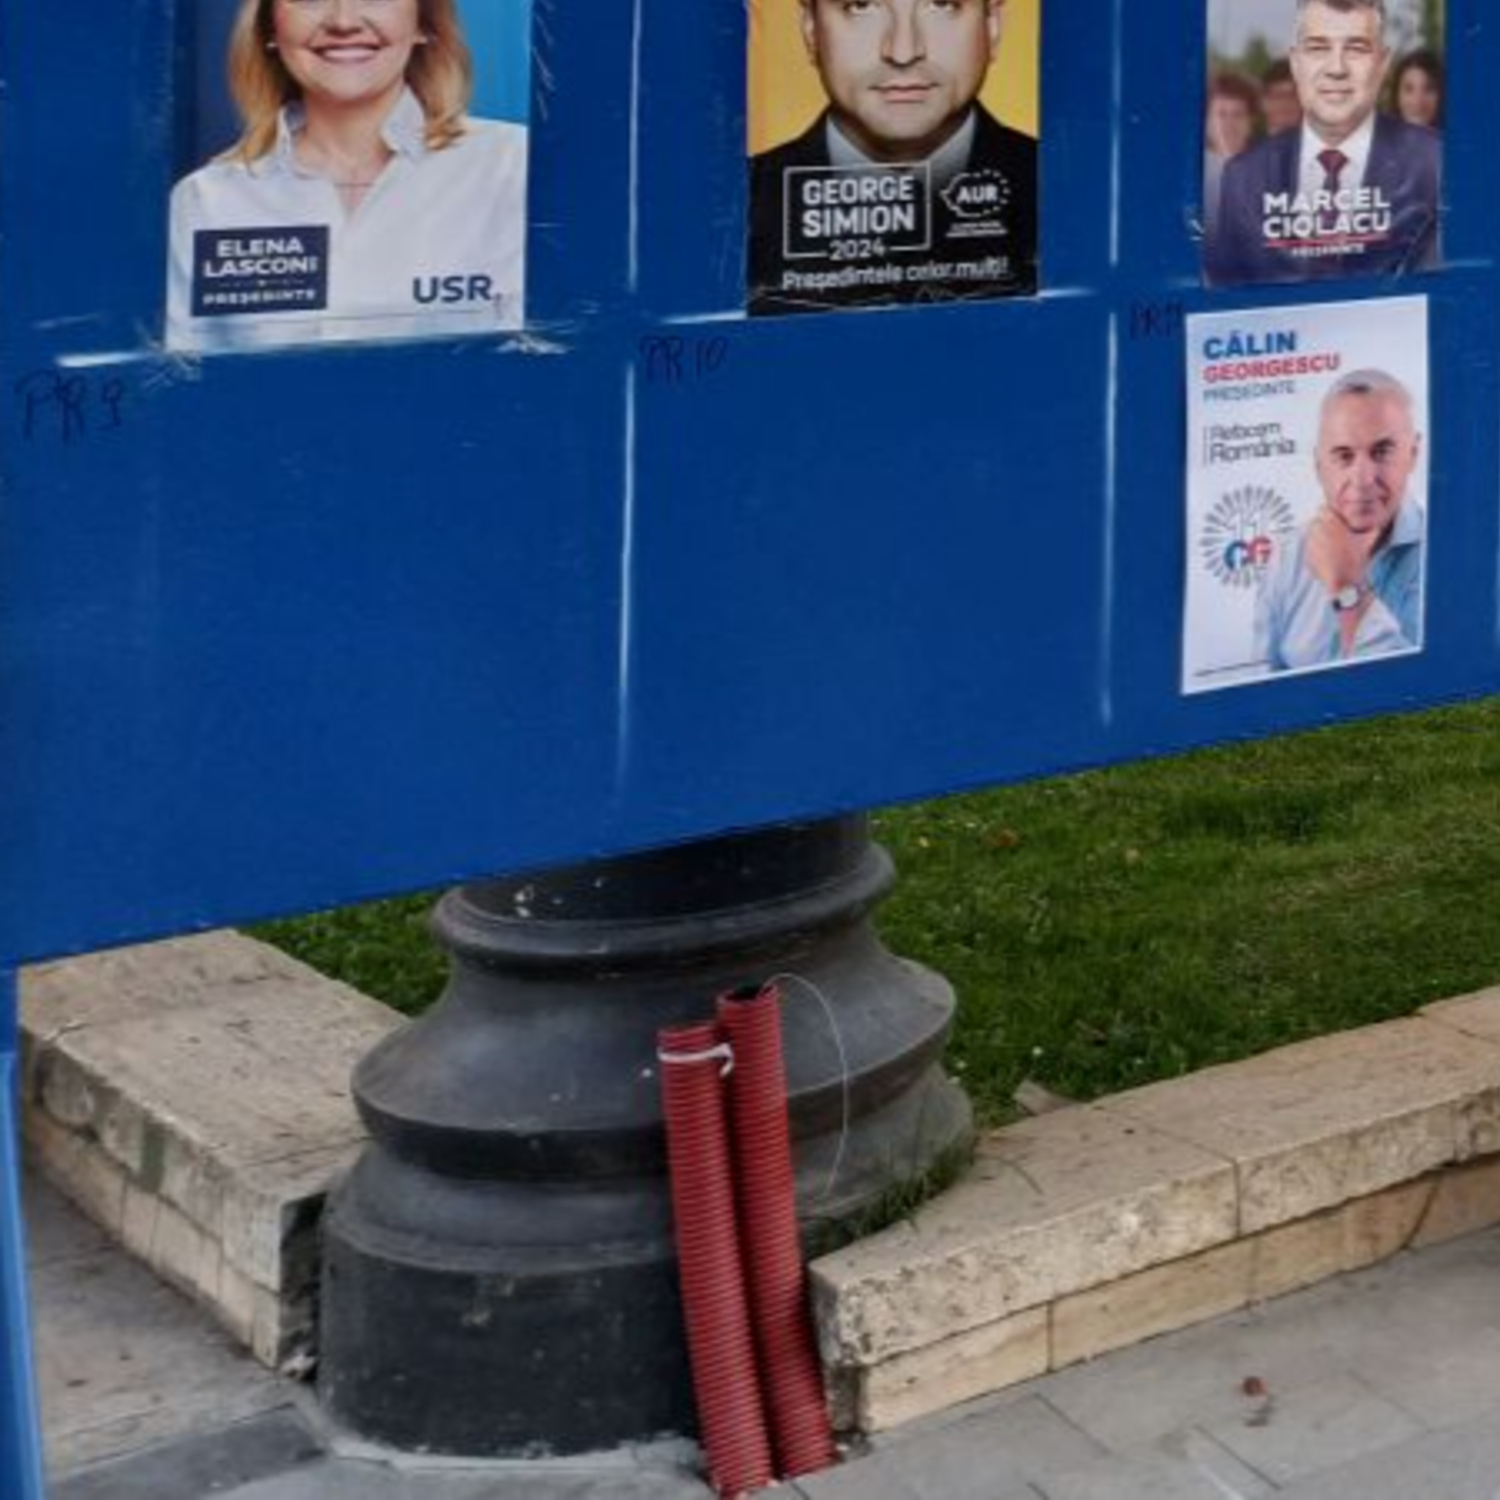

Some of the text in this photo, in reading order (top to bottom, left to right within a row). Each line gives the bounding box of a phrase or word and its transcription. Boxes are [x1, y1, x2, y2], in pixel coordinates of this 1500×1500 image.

[802, 176, 915, 206] GEORGE
[956, 185, 998, 203] AUR
[1262, 187, 1391, 215] MARCEL
[802, 203, 915, 238] SIMION
[1262, 211, 1391, 239] CIOLACU
[216, 236, 304, 258] ELENA
[829, 239, 885, 261] 2024
[203, 255, 319, 279] LASCONI
[1203, 329, 1297, 360] CĂLIN
[1203, 352, 1341, 384] GEORGESCU
